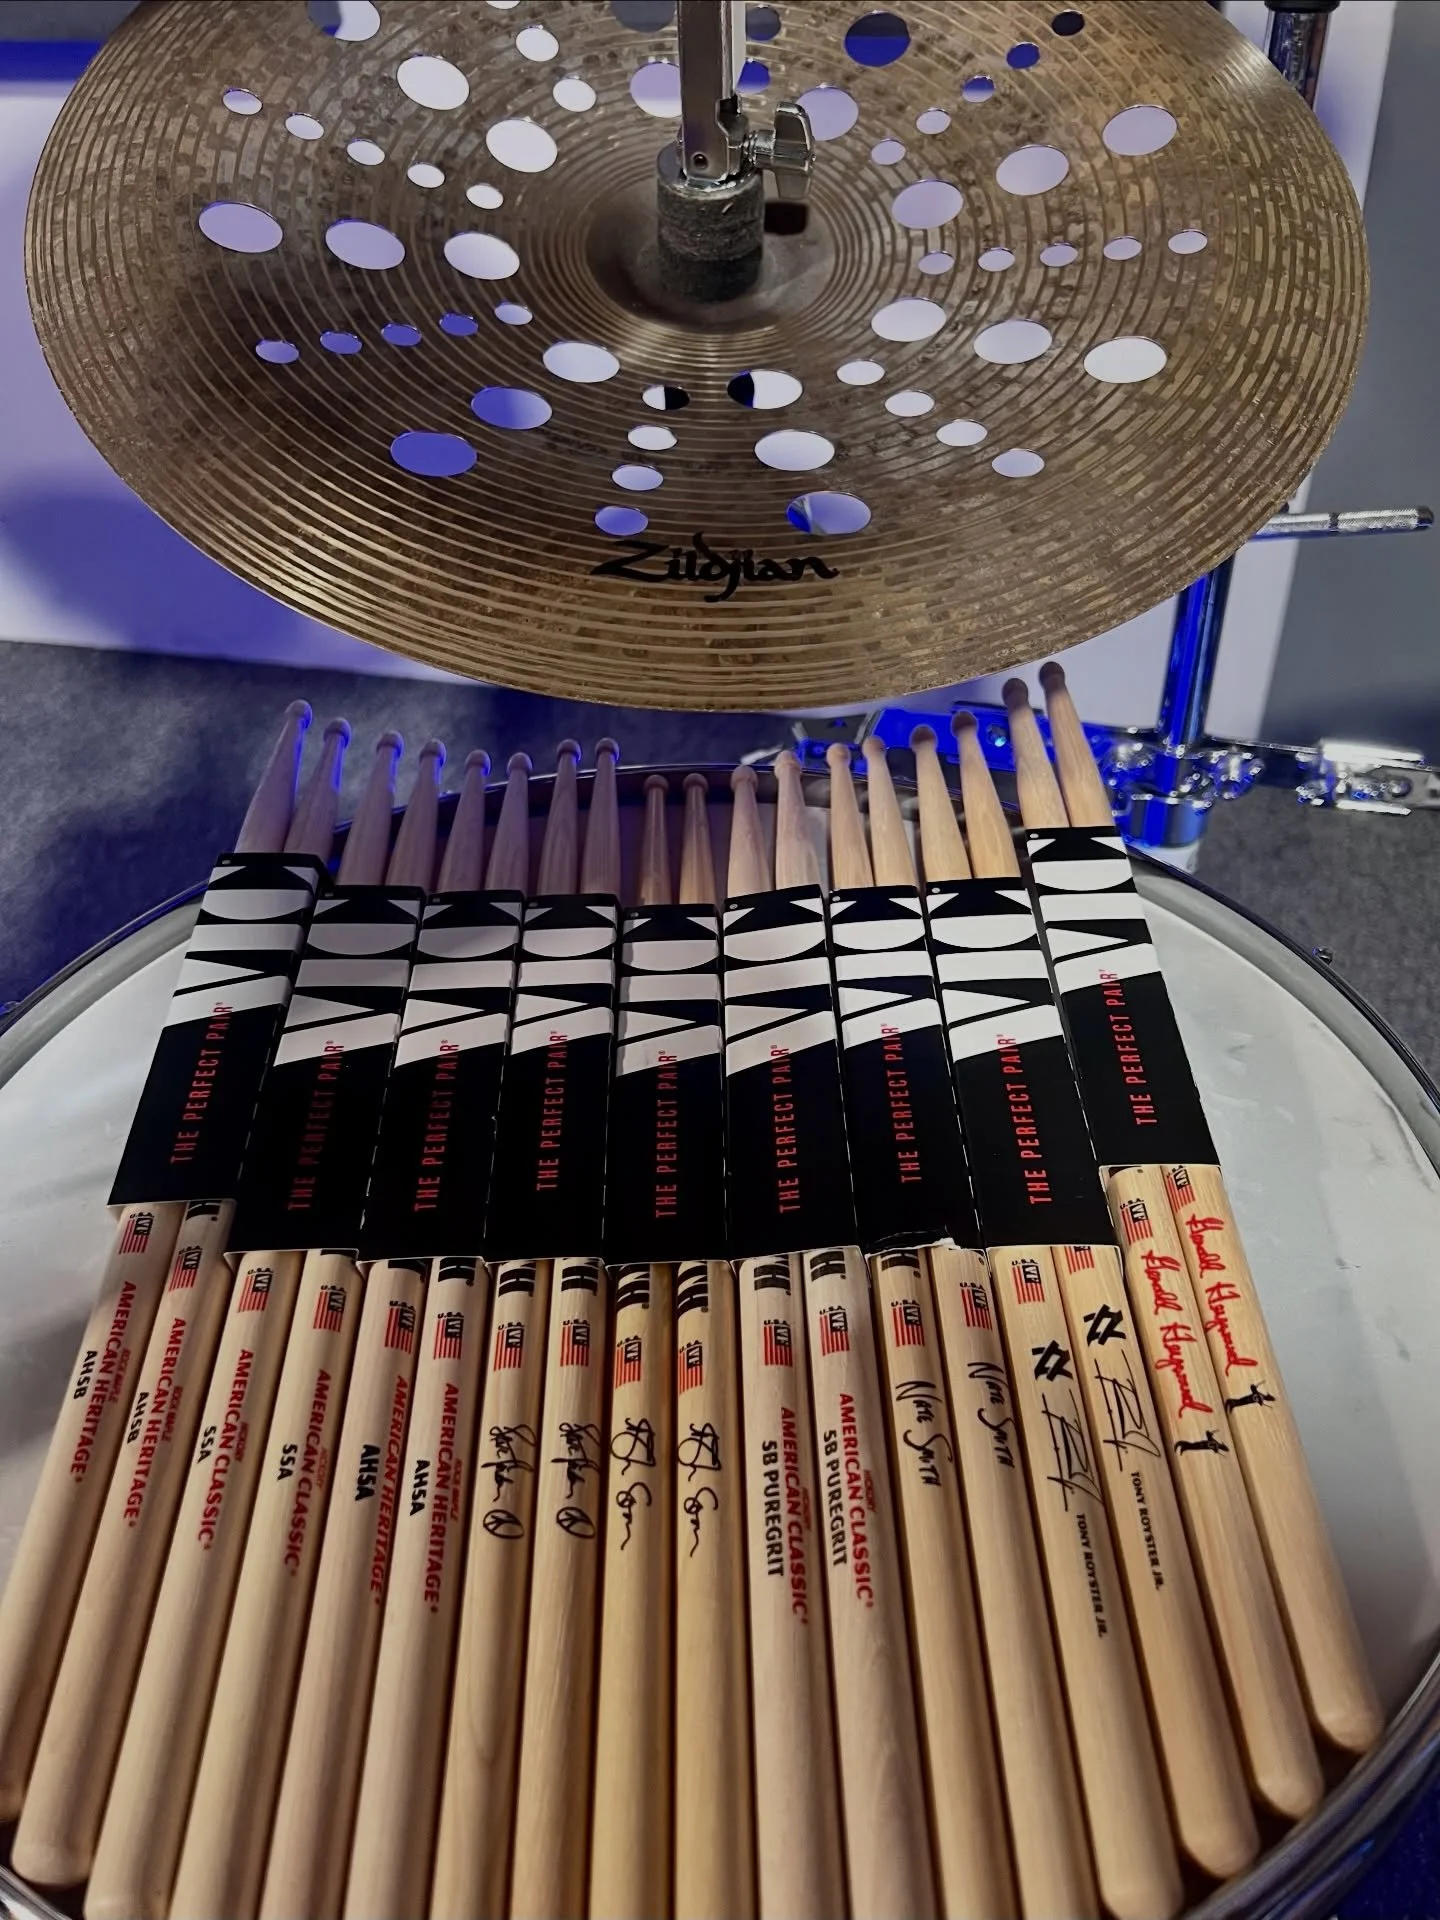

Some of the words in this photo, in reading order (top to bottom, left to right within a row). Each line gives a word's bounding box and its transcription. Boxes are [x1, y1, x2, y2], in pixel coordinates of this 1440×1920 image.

[590, 531, 840, 602] Zildjian
[183, 1049, 221, 1121] PERFECT
[1110, 1014, 1149, 1085] PERFECT
[297, 1090, 335, 1164] PERFECT
[422, 1090, 453, 1166] PERFECT
[540, 1078, 565, 1149] PERFECT
[656, 1099, 677, 1174] PERFECT
[774, 1094, 798, 1169] PERFECT
[888, 1070, 914, 1141] PERFECT
[1004, 1082, 1043, 1160] PERFECT
[1129, 1093, 1158, 1126] THE
[170, 1130, 199, 1164] THE
[536, 1158, 559, 1191] THE
[898, 1150, 922, 1184] THE
[288, 1170, 316, 1210] THE
[414, 1177, 440, 1212] THE
[656, 1184, 677, 1218] THE
[779, 1177, 801, 1214] THE
[1025, 1169, 1053, 1205] THE
[98, 1281, 137, 1375] AMERICAN
[150, 1318, 187, 1415] AMERICAN
[218, 1349, 254, 1450] AMERICAN
[301, 1370, 330, 1473] AMERICAN
[383, 1375, 408, 1482] AMERICAN
[435, 1383, 459, 1489] AMERICAN
[762, 1441, 778, 1465] 5B
[824, 1430, 837, 1456] 5B
[839, 1393, 862, 1501] AMERICAN
[355, 1445, 380, 1500] AH5A
[410, 1460, 430, 1516] AH5A
[780, 1407, 802, 1516] AMERICAN
[764, 1470, 784, 1576] PUREGRIT
[826, 1459, 847, 1566] PUREGRIT
[1131, 1472, 1146, 1504] TONY
[1139, 1508, 1160, 1566] ROYSTER
[1152, 1570, 1164, 1590] JR.
[1076, 1514, 1091, 1548] TONY
[1084, 1552, 1103, 1613] ROYSTER
[1096, 1616, 1107, 1637] JR.
